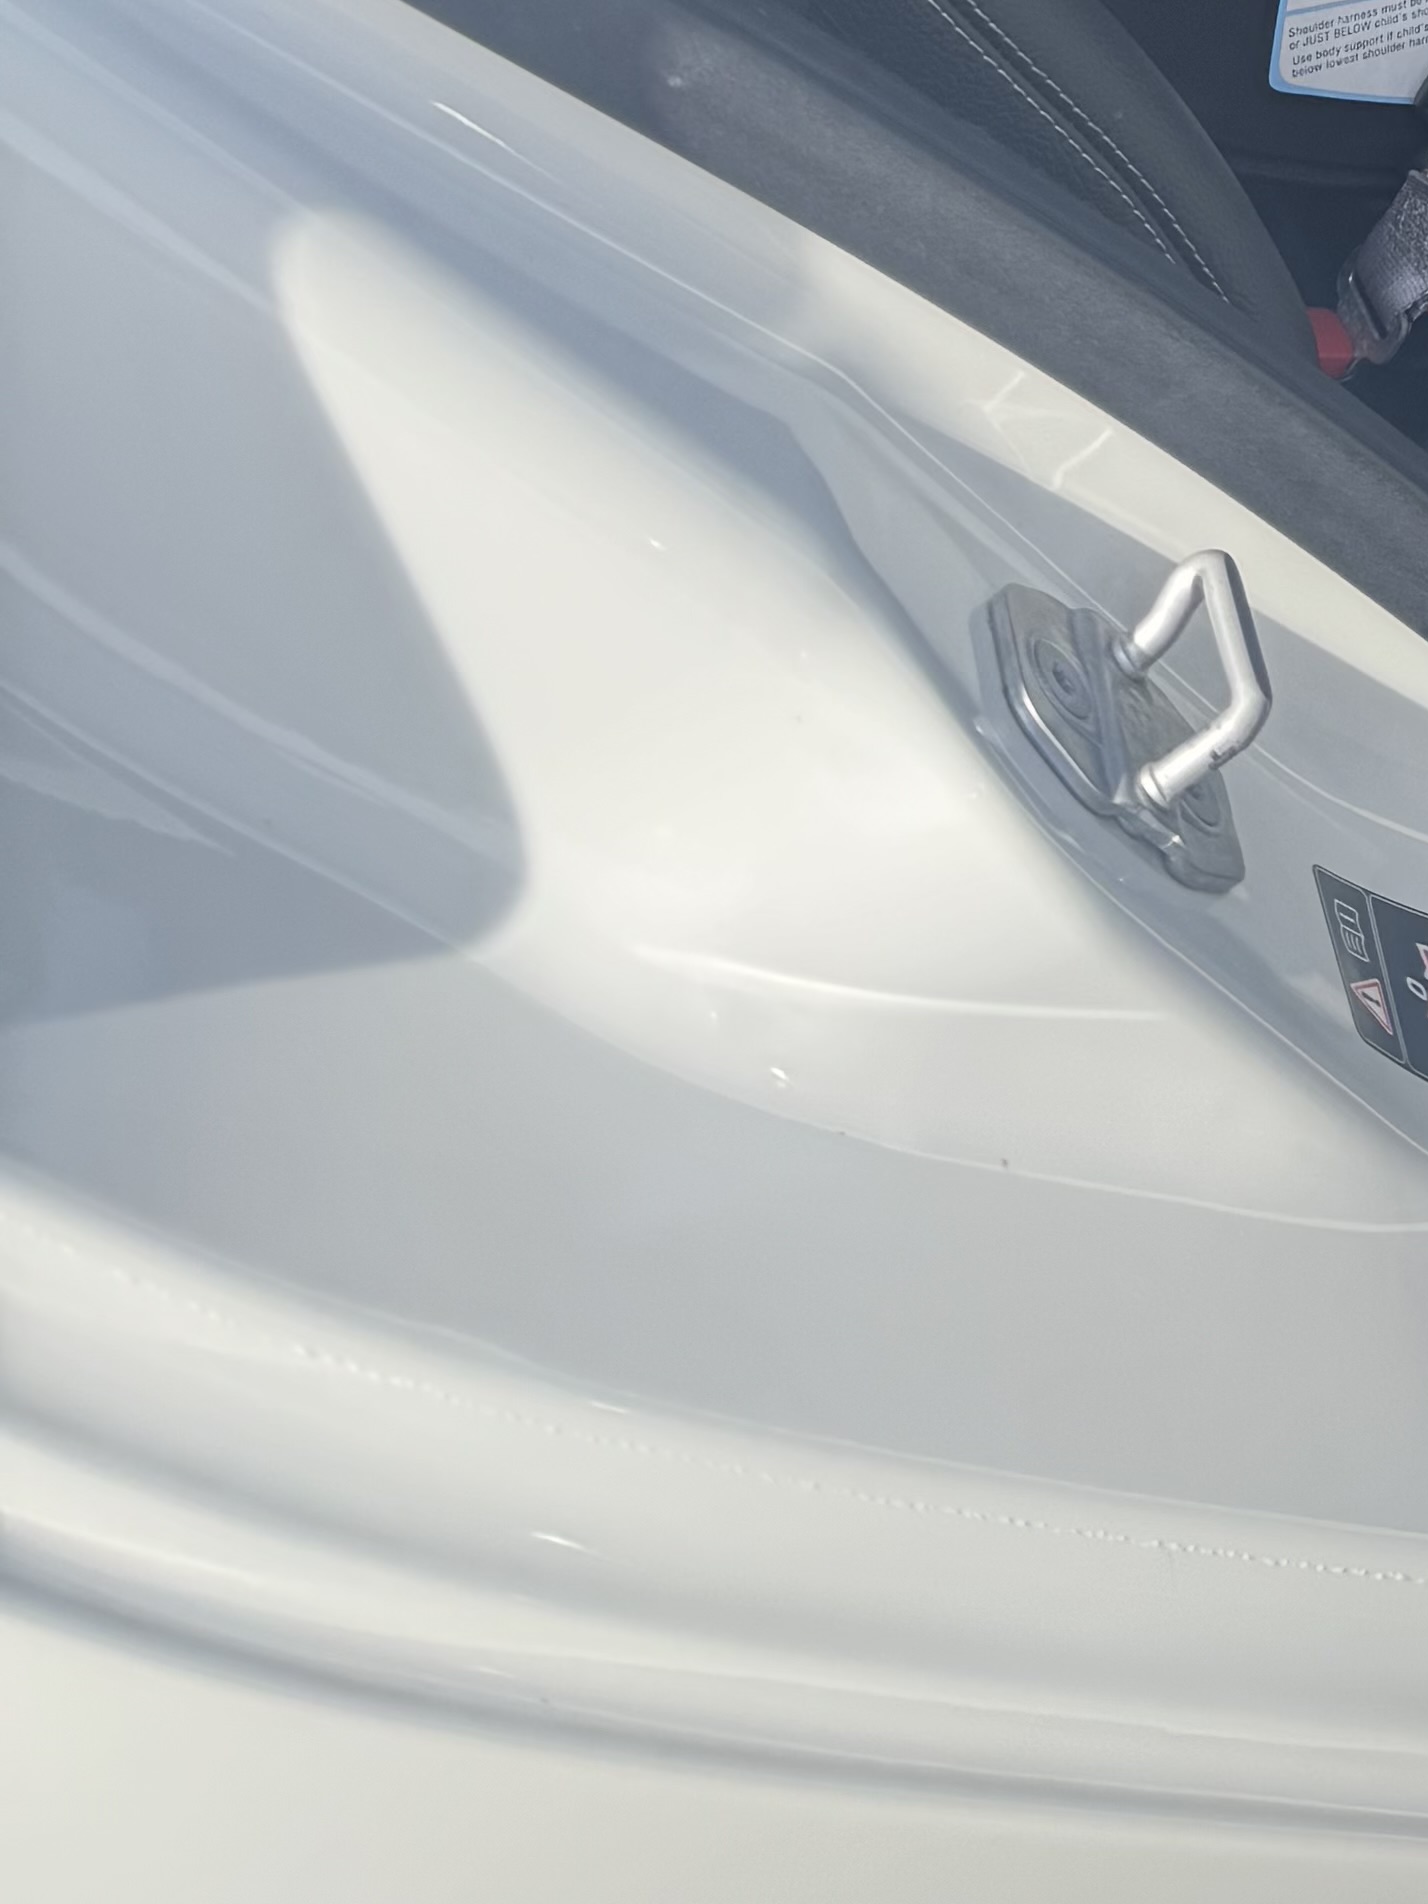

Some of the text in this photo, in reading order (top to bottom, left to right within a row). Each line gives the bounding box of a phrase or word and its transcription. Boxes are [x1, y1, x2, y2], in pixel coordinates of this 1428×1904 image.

[1288, 15, 1334, 38] Shoulder
[1337, 5, 1377, 25] harness
[1381, 0, 1406, 14] must
[1289, 38, 1300, 51] or
[1303, 30, 1330, 46] JUST
[1334, 19, 1371, 39] BELOW
[1374, 11, 1407, 28] child's
